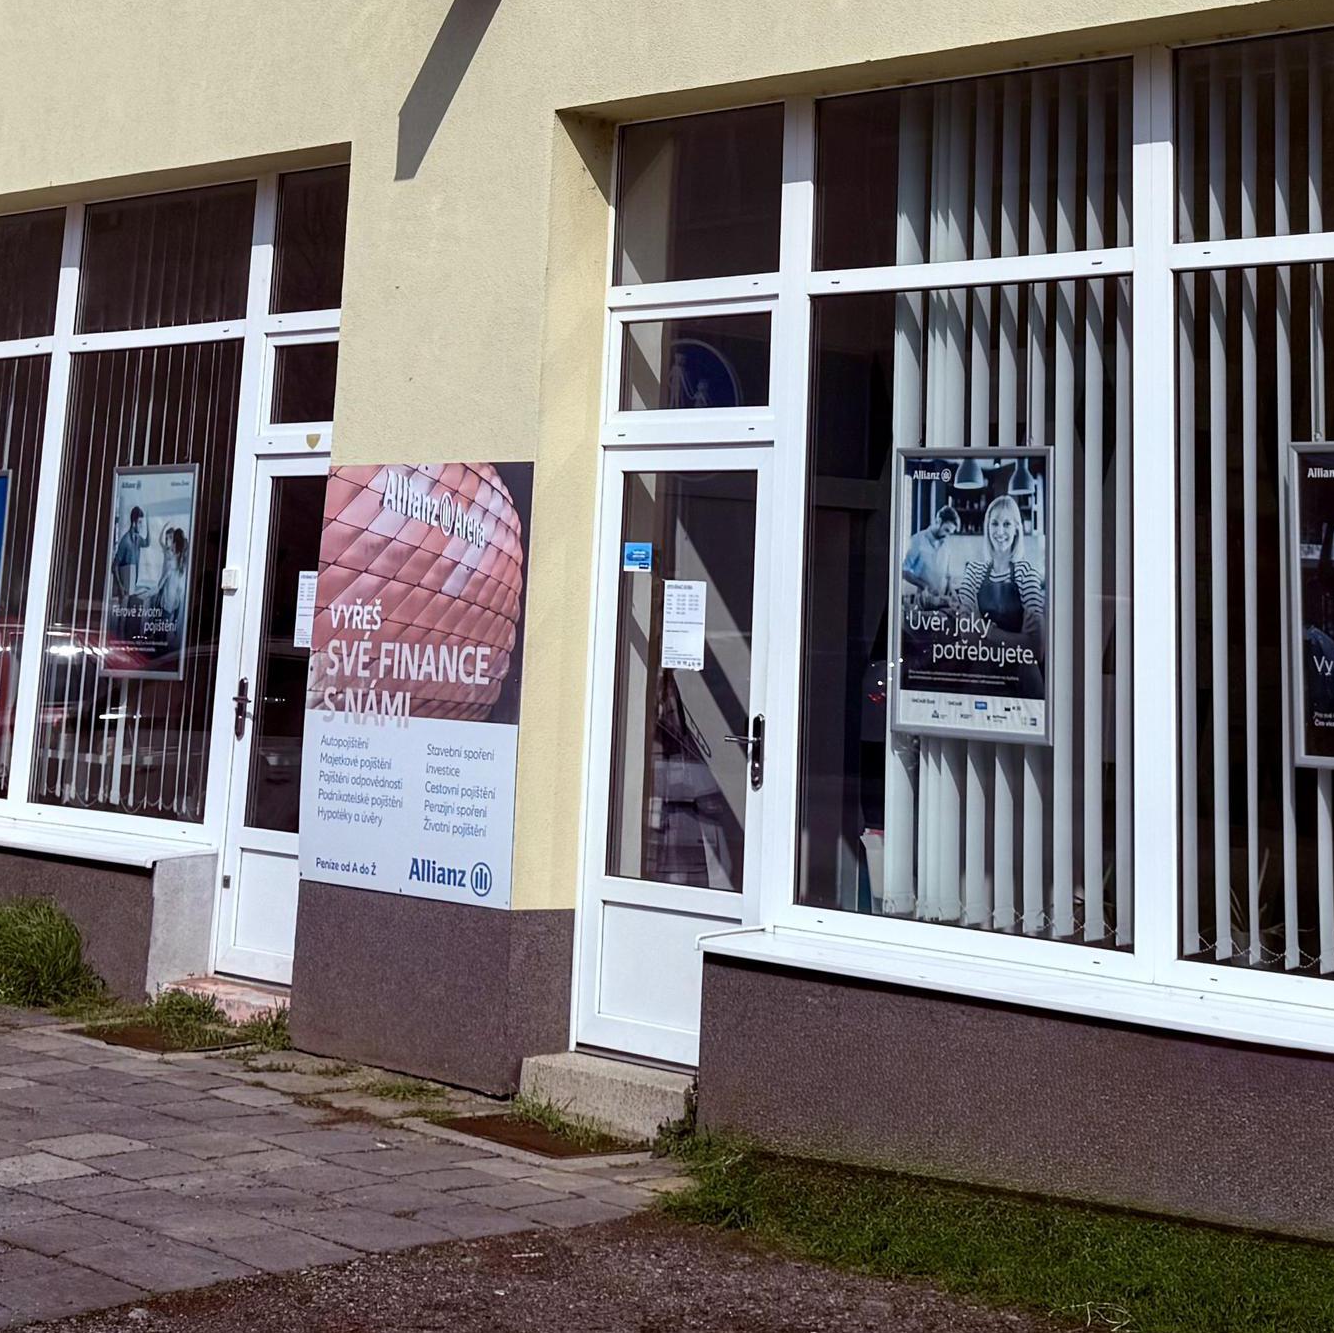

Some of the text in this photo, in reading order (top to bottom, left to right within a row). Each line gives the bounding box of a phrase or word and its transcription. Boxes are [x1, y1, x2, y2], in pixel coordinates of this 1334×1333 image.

[913, 469, 940, 480] Allianz
[383, 469, 486, 549] Allianz Arena
[330, 598, 382, 630] VYŘEŠ
[909, 604, 992, 639] Úvěr, jaký
[144, 618, 178, 634] pojištění
[326, 631, 491, 685] SVÉ FINANCE
[933, 639, 1038, 667] potřebujete.
[323, 679, 411, 729] S NÁMI
[320, 735, 370, 750] Autopojištění
[427, 743, 495, 761] Stavební spoření
[319, 752, 392, 770] Majetkové pojištění
[426, 763, 460, 777] Investice
[319, 770, 403, 789] Pojištění odpovědnosti
[318, 788, 403, 809] Podnikatelské pojištění
[425, 781, 496, 800] Cestovní pojištění
[317, 806, 383, 827] Hypotéky a úvěry
[424, 799, 487, 818] Penzijní spoření
[423, 815, 487, 837] Životní pojištění
[316, 857, 377, 876] Peníze od A do Ž
[408, 857, 467, 888] Allianz
